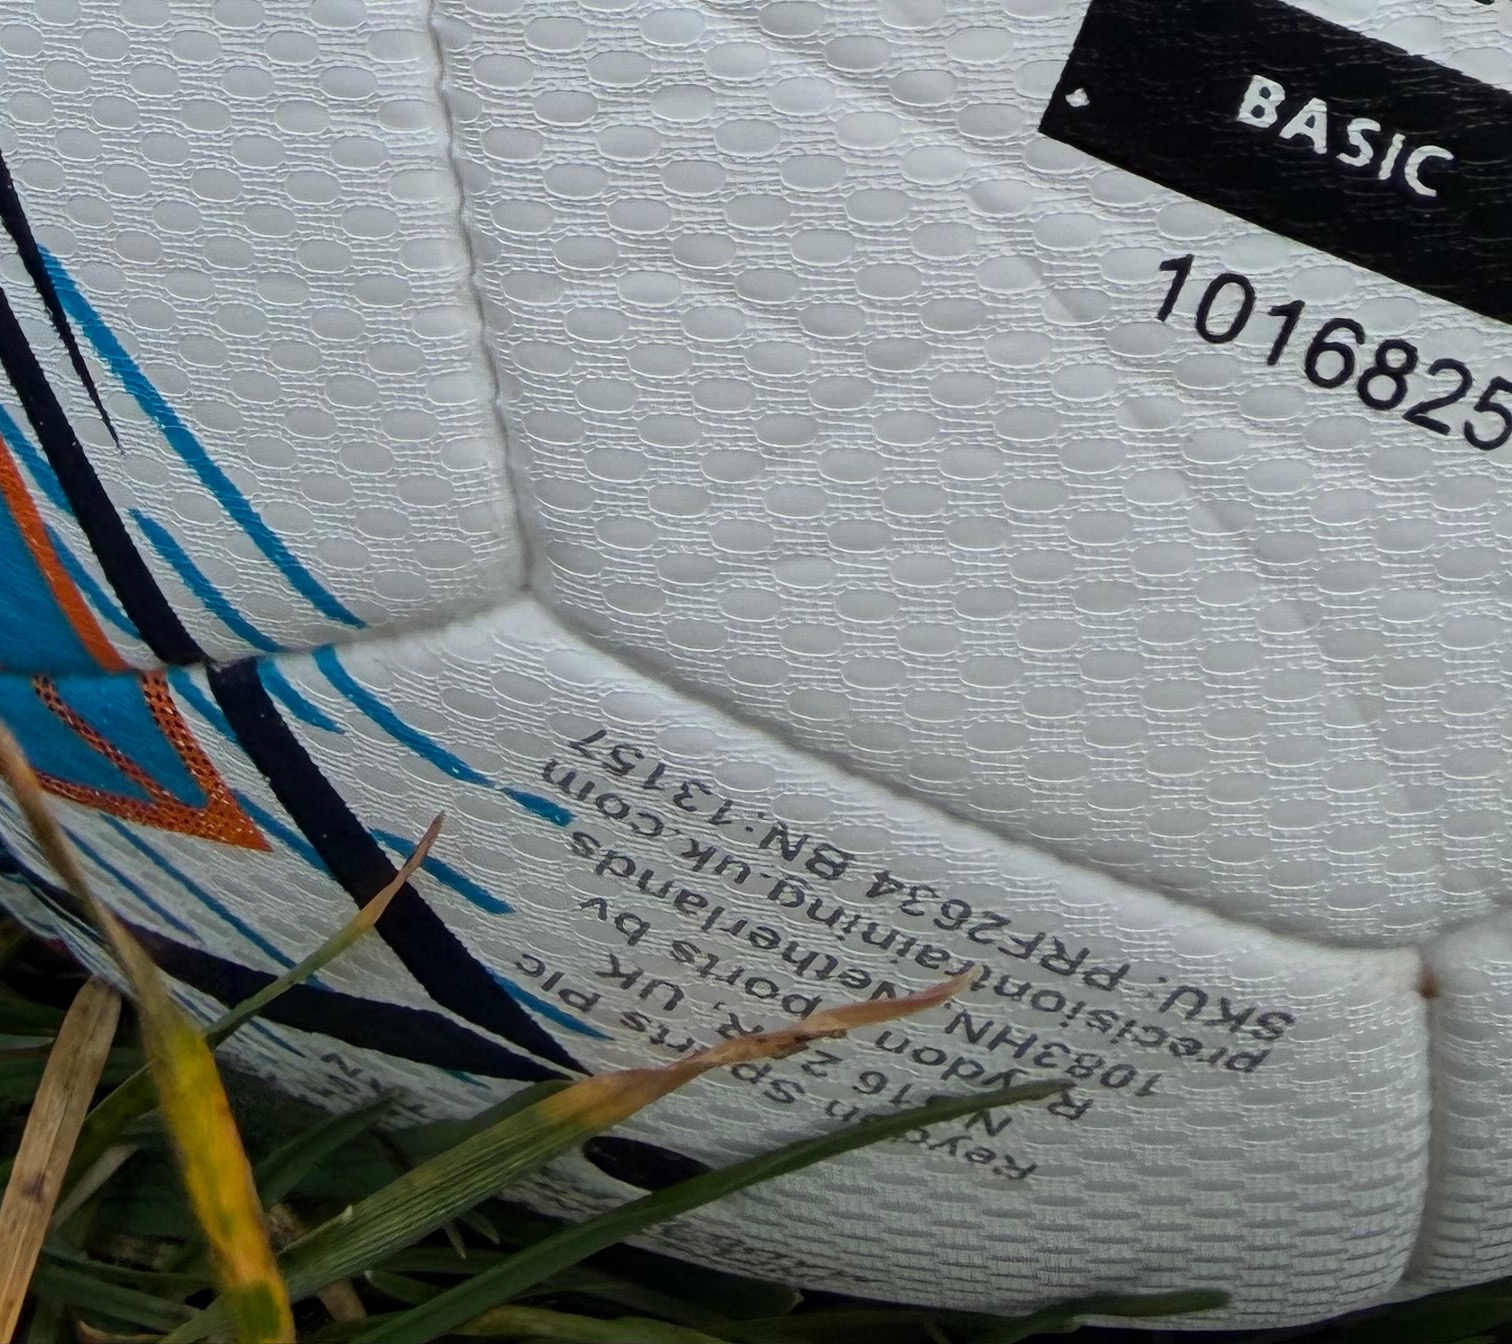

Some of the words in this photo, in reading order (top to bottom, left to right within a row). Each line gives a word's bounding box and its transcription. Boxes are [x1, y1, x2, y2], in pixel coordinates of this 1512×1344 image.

[1236, 73, 1456, 200] BASIC
[1154, 252, 1512, 451] 1016825
[580, 896, 652, 947] bv
[865, 869, 1132, 992] PRF2634
[515, 952, 604, 1013] Plc
[595, 952, 686, 1012] UK
[668, 938, 833, 1022] ports
[1140, 975, 1296, 1042] SKU:
[619, 1009, 806, 1104] Sprts
[712, 1000, 843, 1079] 2R,
[874, 1030, 1094, 1122] Rydon
[852, 1068, 1014, 1137] N16
